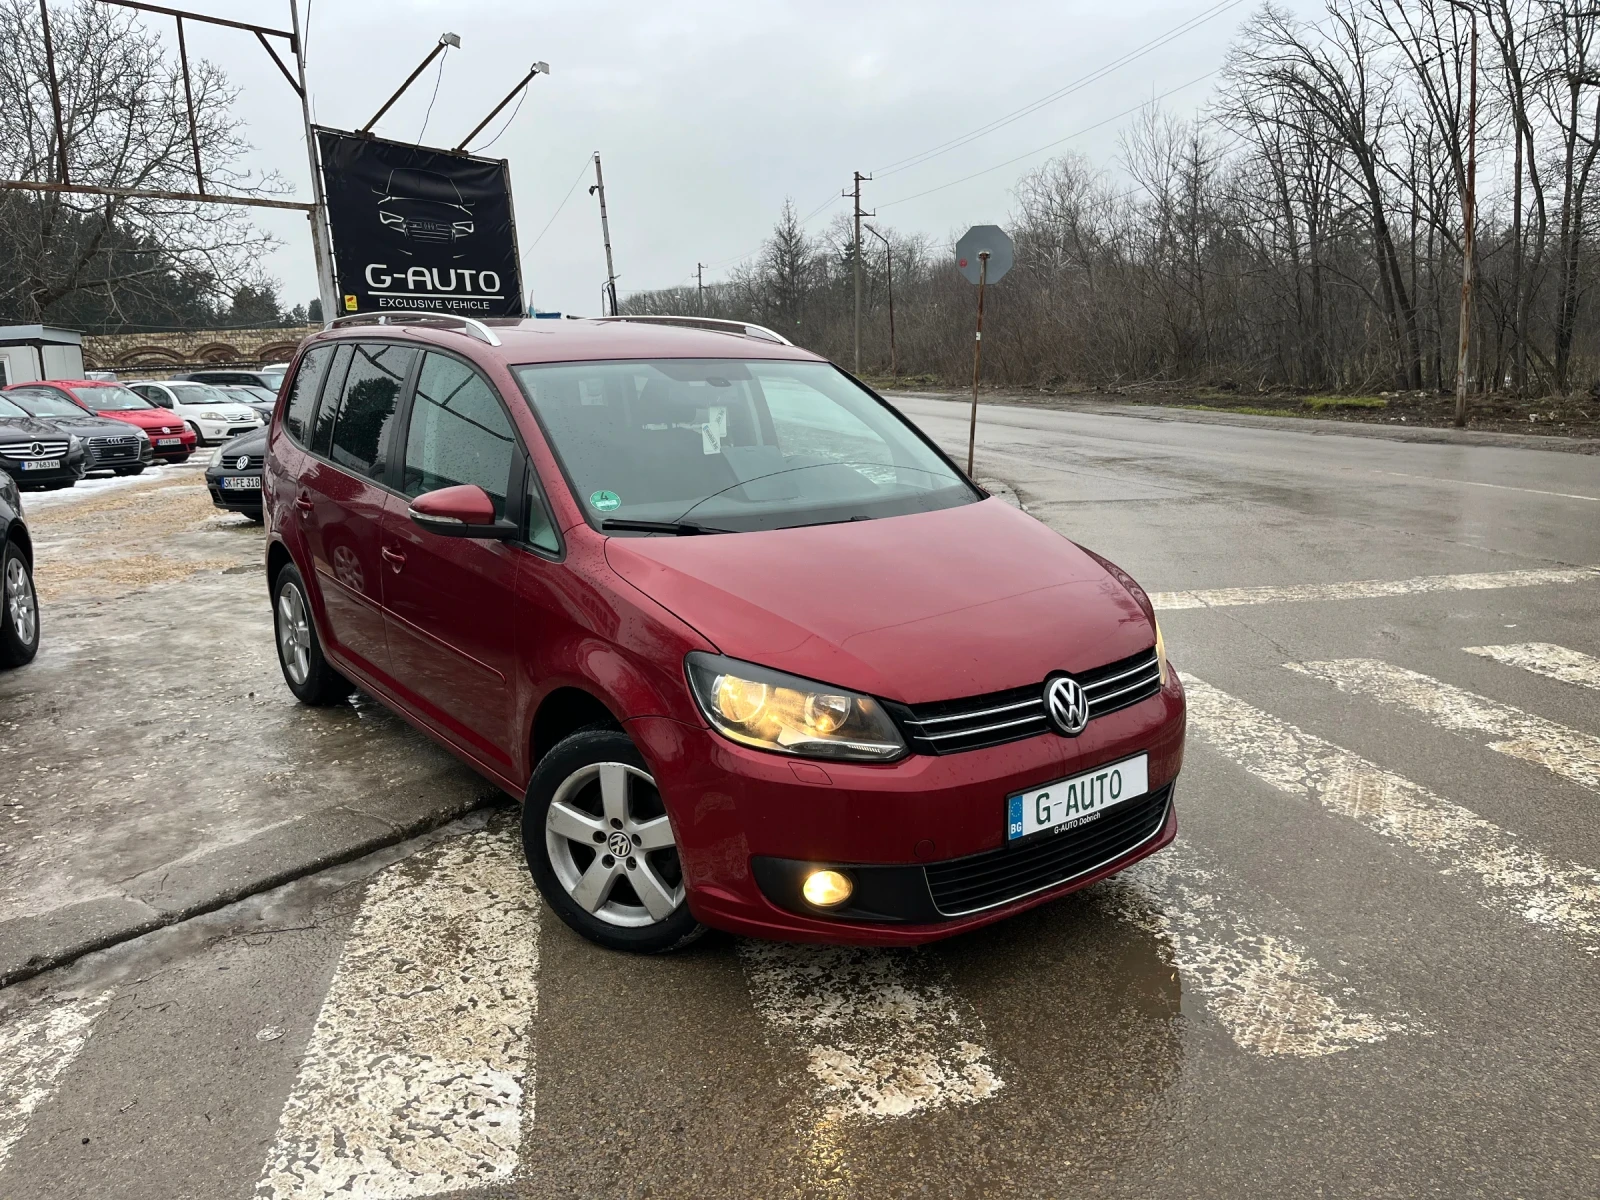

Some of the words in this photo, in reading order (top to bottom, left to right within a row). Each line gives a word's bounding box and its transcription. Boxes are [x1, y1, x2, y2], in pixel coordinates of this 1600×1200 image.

[365, 263, 501, 292] G-AUTO
[379, 297, 443, 309] EXCLUSIVE
[445, 299, 490, 310] VEHICLE
[246, 477, 260, 488] 318
[600, 491, 610, 501] 4
[1035, 769, 1122, 826] G-AUTO
[1010, 821, 1023, 835] BG
[1053, 819, 1079, 834] G-AUTO
[1078, 811, 1101, 828] Dobrich
